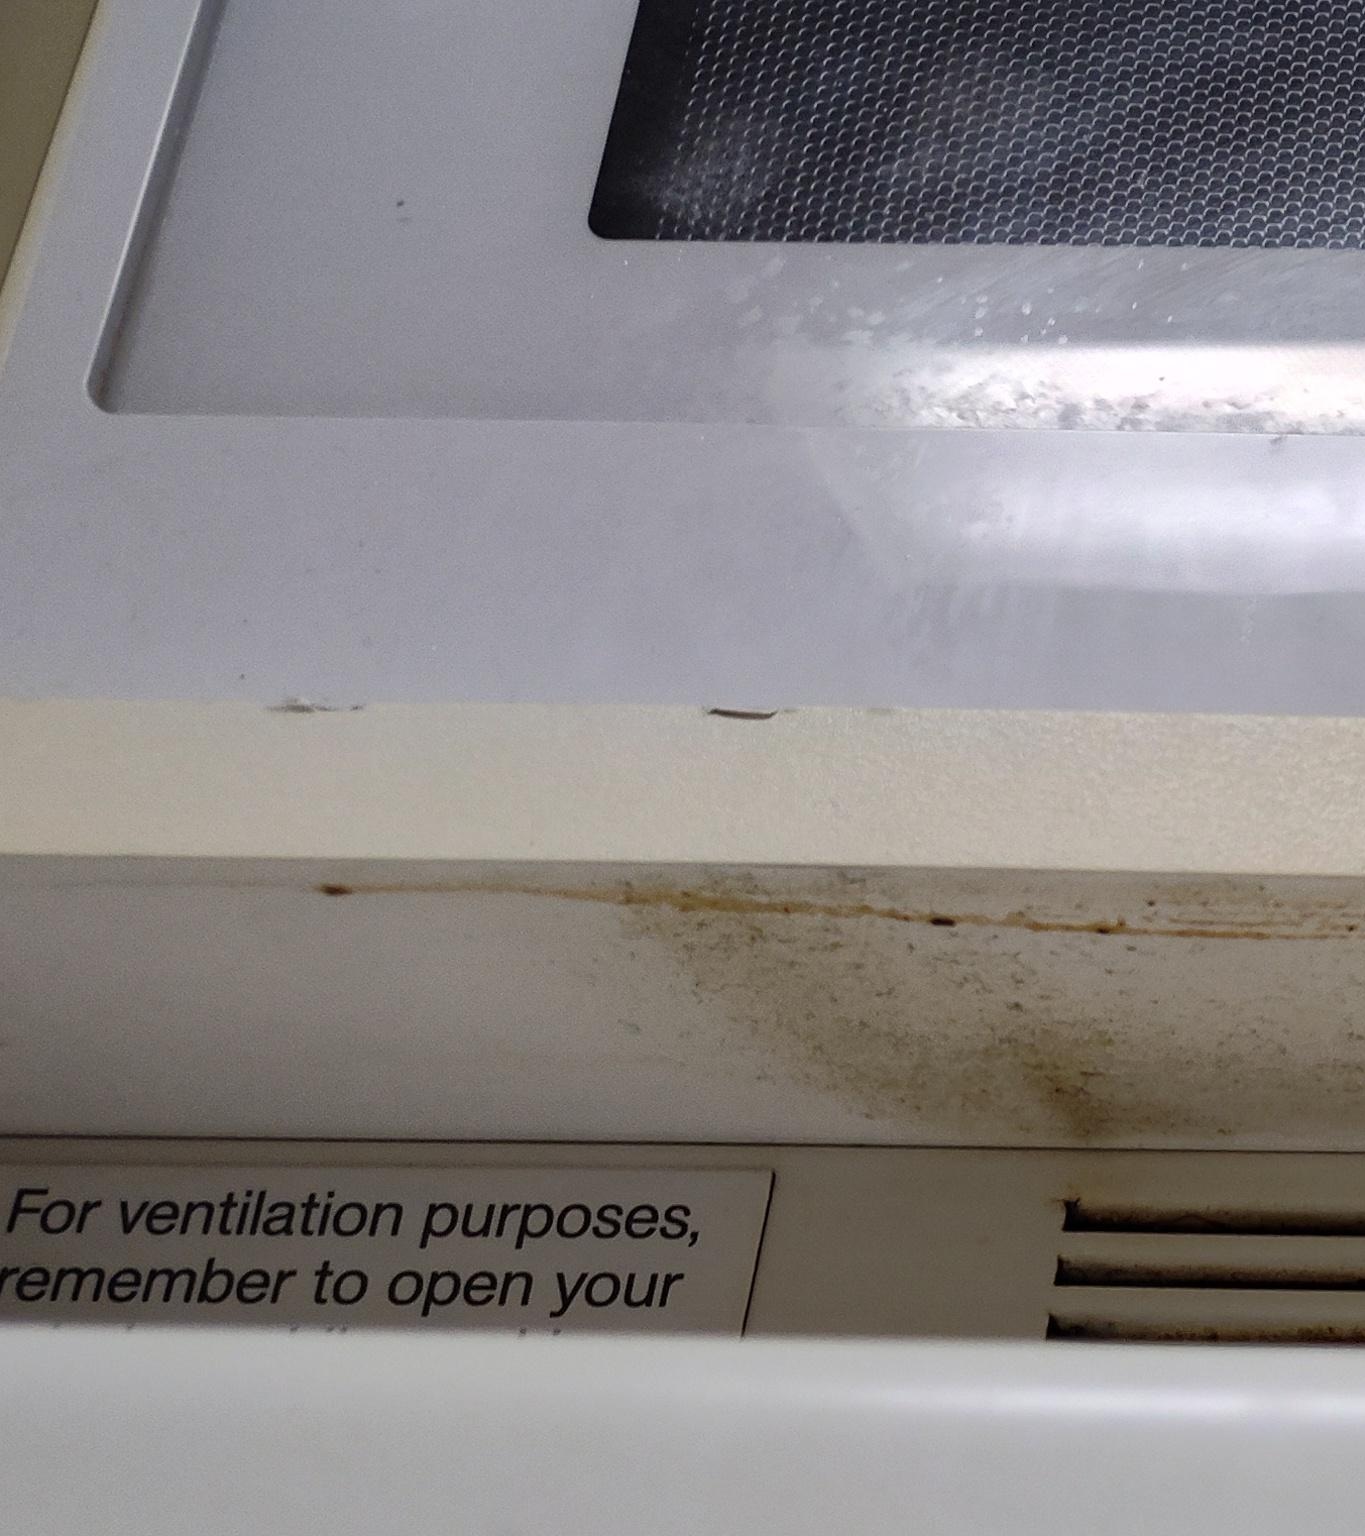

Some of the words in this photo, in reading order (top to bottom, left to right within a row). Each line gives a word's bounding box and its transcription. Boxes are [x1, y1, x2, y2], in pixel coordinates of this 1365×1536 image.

[6, 1187, 103, 1235] For
[119, 1189, 404, 1237] ventilation
[418, 1202, 699, 1250] purposes,
[0, 1257, 298, 1305] remember
[313, 1259, 369, 1306] to
[387, 1270, 534, 1318] open
[549, 1271, 685, 1319] your
